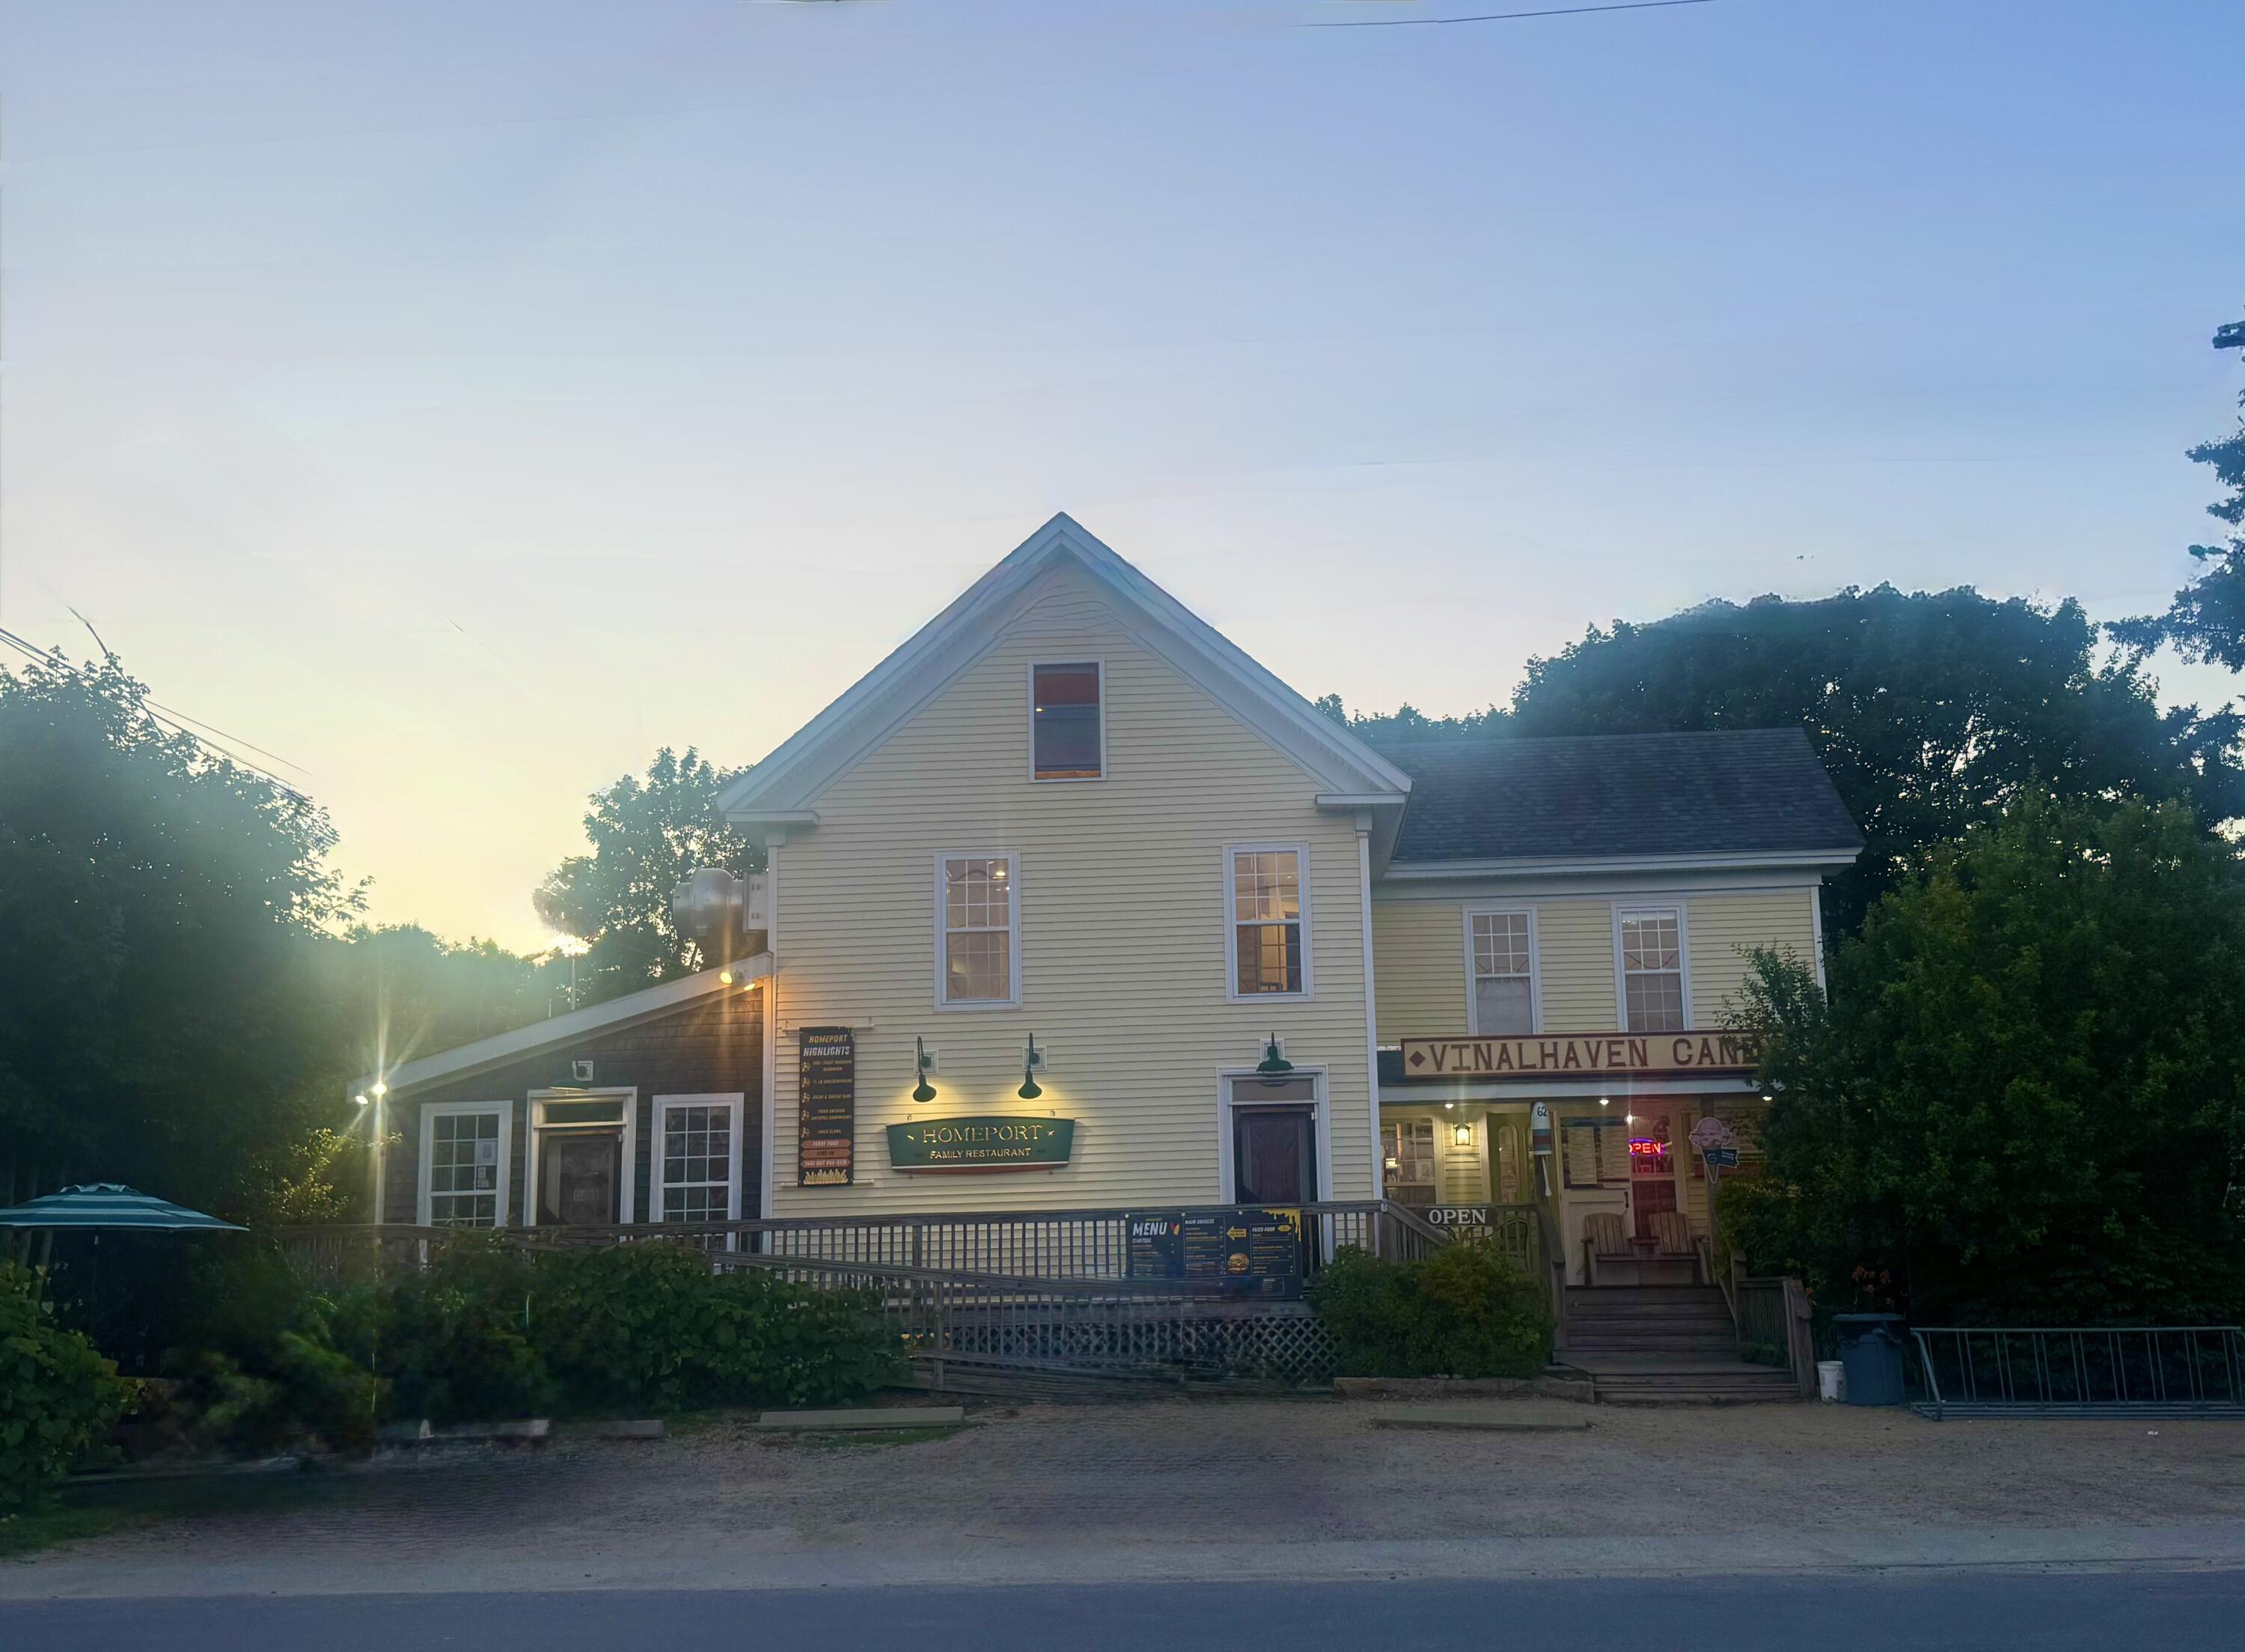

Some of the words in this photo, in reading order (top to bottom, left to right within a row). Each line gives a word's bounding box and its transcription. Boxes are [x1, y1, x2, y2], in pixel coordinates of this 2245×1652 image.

[809, 1034, 848, 1044] HOMEPORT
[803, 1046, 850, 1056] HIGHLIGHTS
[1429, 1038, 1648, 1072] VINALHAVEN
[1536, 1105, 1548, 1117] 62
[922, 1125, 1042, 1144] HOMEPORT
[929, 1150, 964, 1159] FAMILY
[966, 1148, 1031, 1158] RESTAURANT
[1429, 1208, 1486, 1225] OPEN
[1132, 1222, 1167, 1236] MENU
